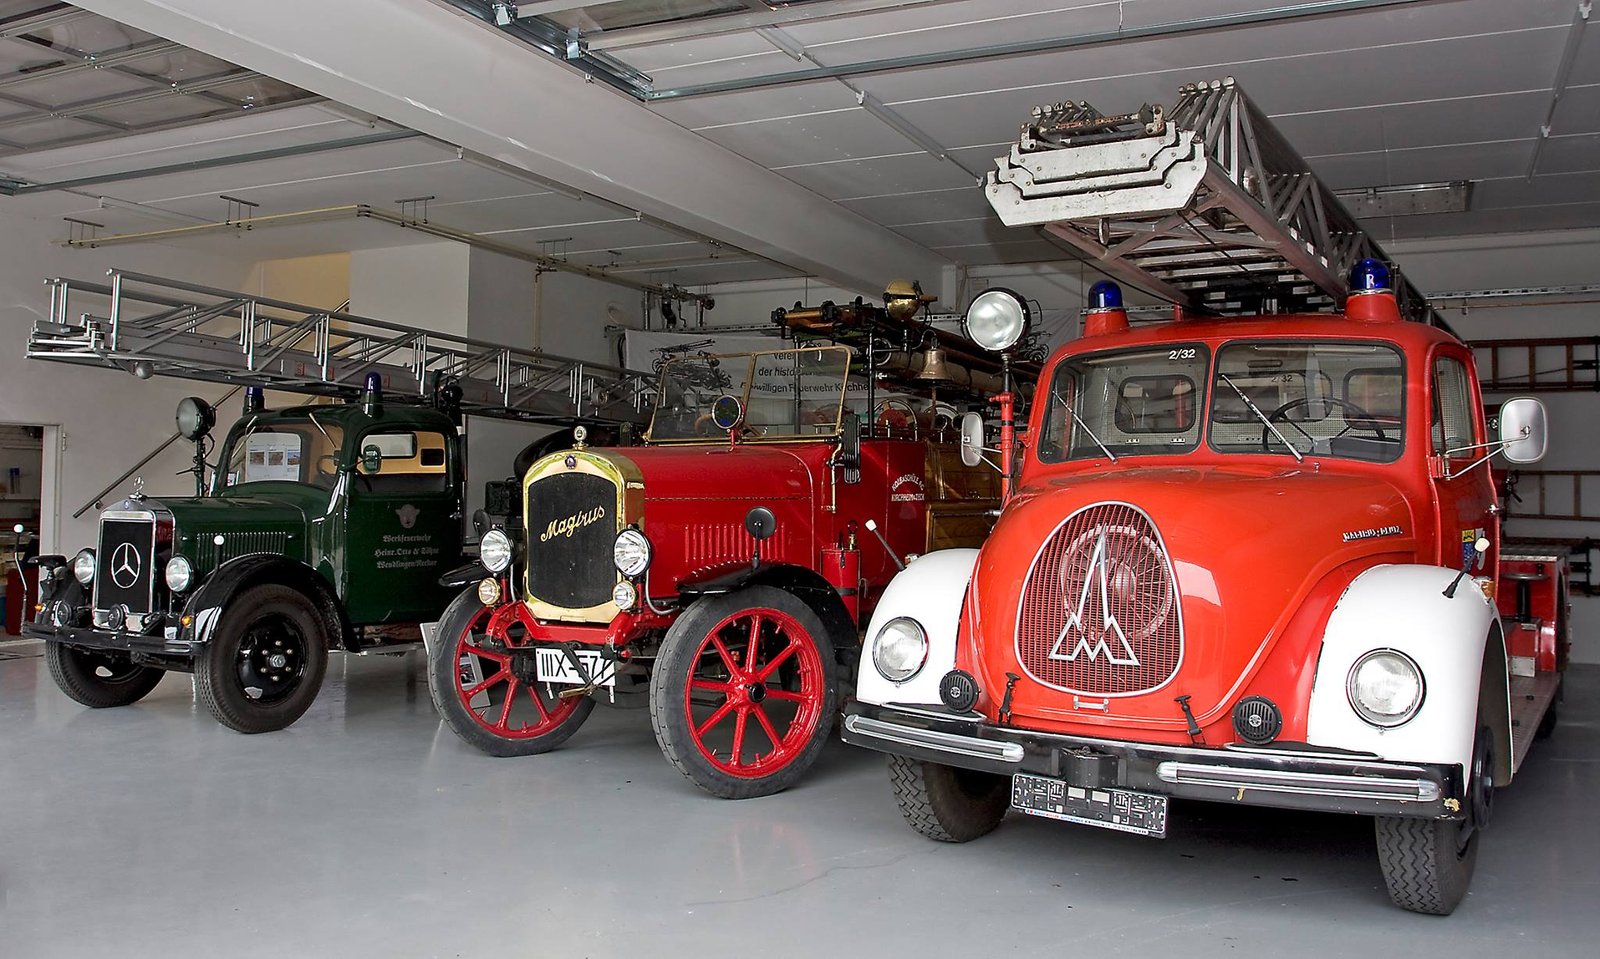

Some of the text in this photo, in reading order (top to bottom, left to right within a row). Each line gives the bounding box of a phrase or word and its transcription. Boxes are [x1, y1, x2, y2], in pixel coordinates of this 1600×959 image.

[1168, 348, 1196, 360] 2/32
[758, 367, 773, 377] der
[540, 505, 605, 542] Magirus
